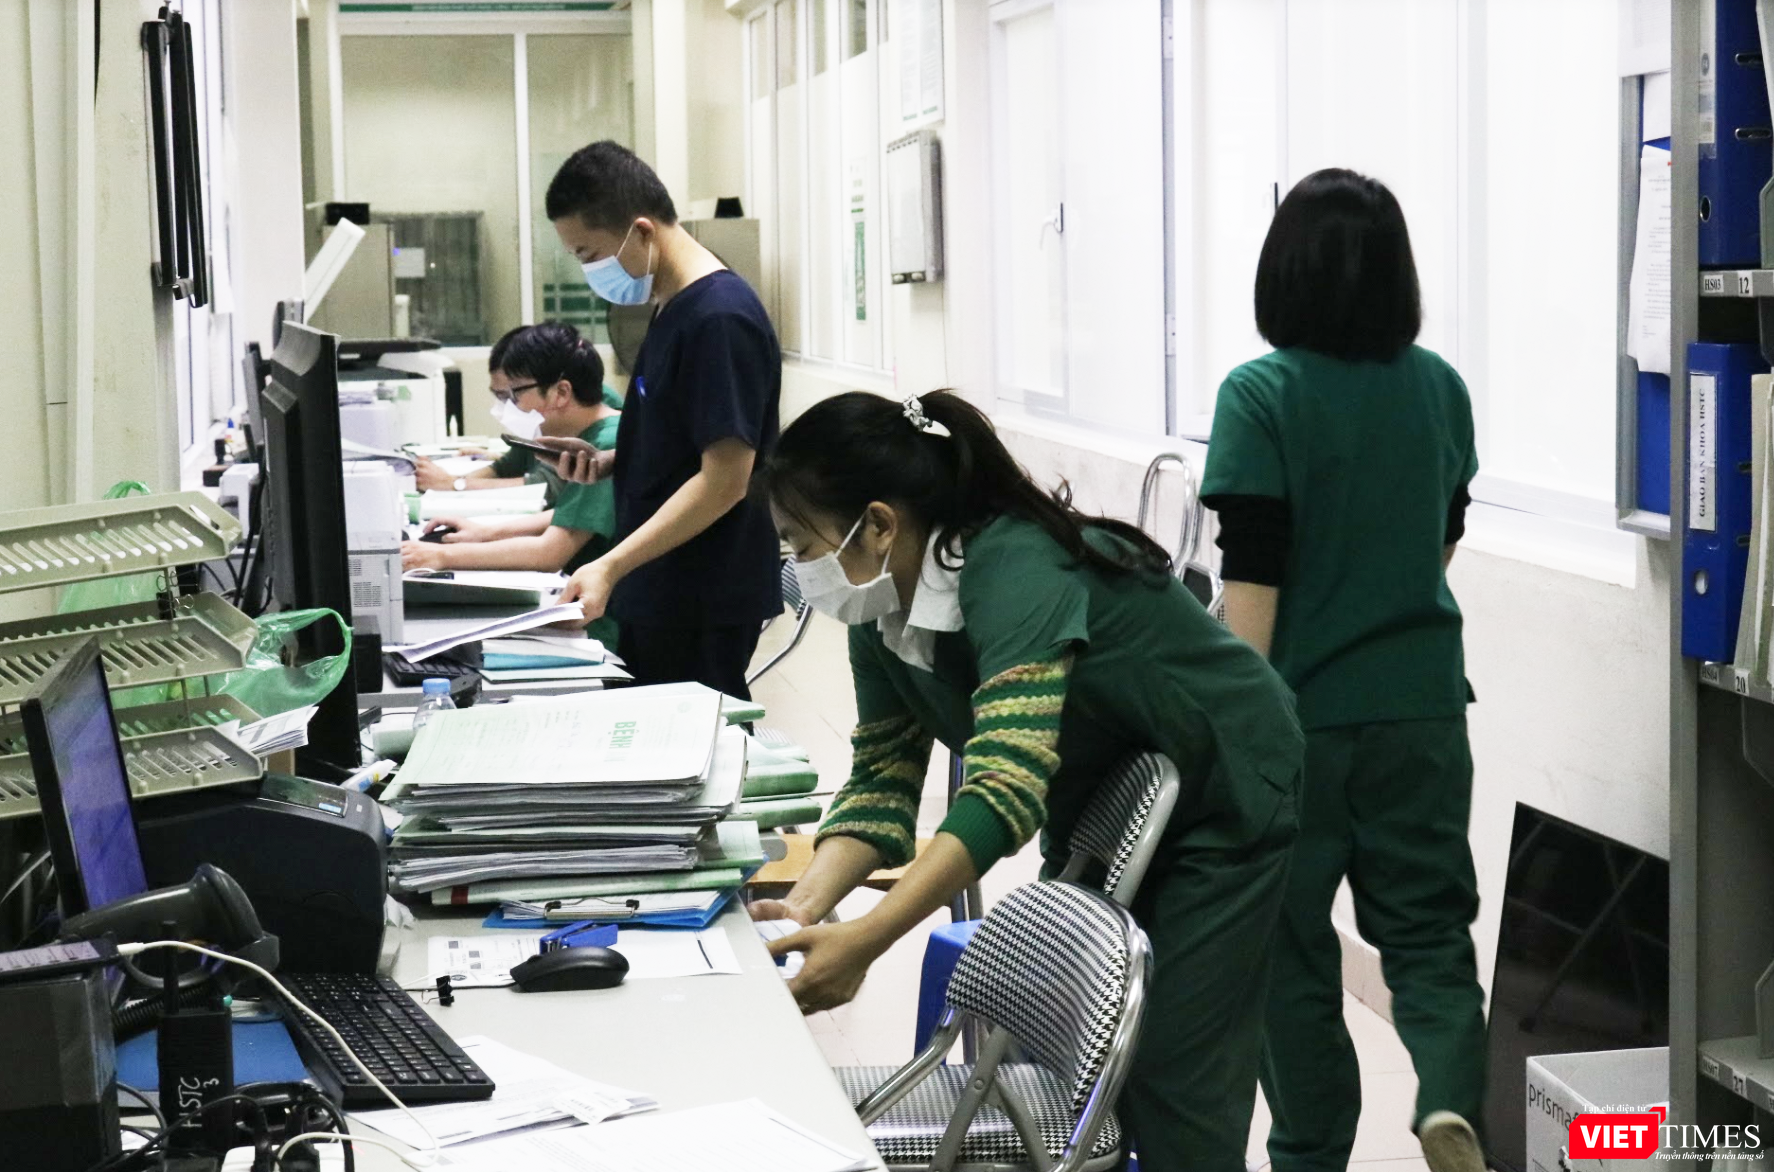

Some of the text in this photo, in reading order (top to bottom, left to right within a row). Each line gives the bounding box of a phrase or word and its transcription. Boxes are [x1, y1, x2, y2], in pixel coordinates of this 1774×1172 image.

[1739, 277, 1749, 294] 12
[1736, 675, 1746, 693] 20
[607, 720, 640, 750] BỆNH
[203, 1077, 220, 1089] 3
[1733, 1075, 1744, 1095] 27
[178, 1076, 203, 1128] HSTC
